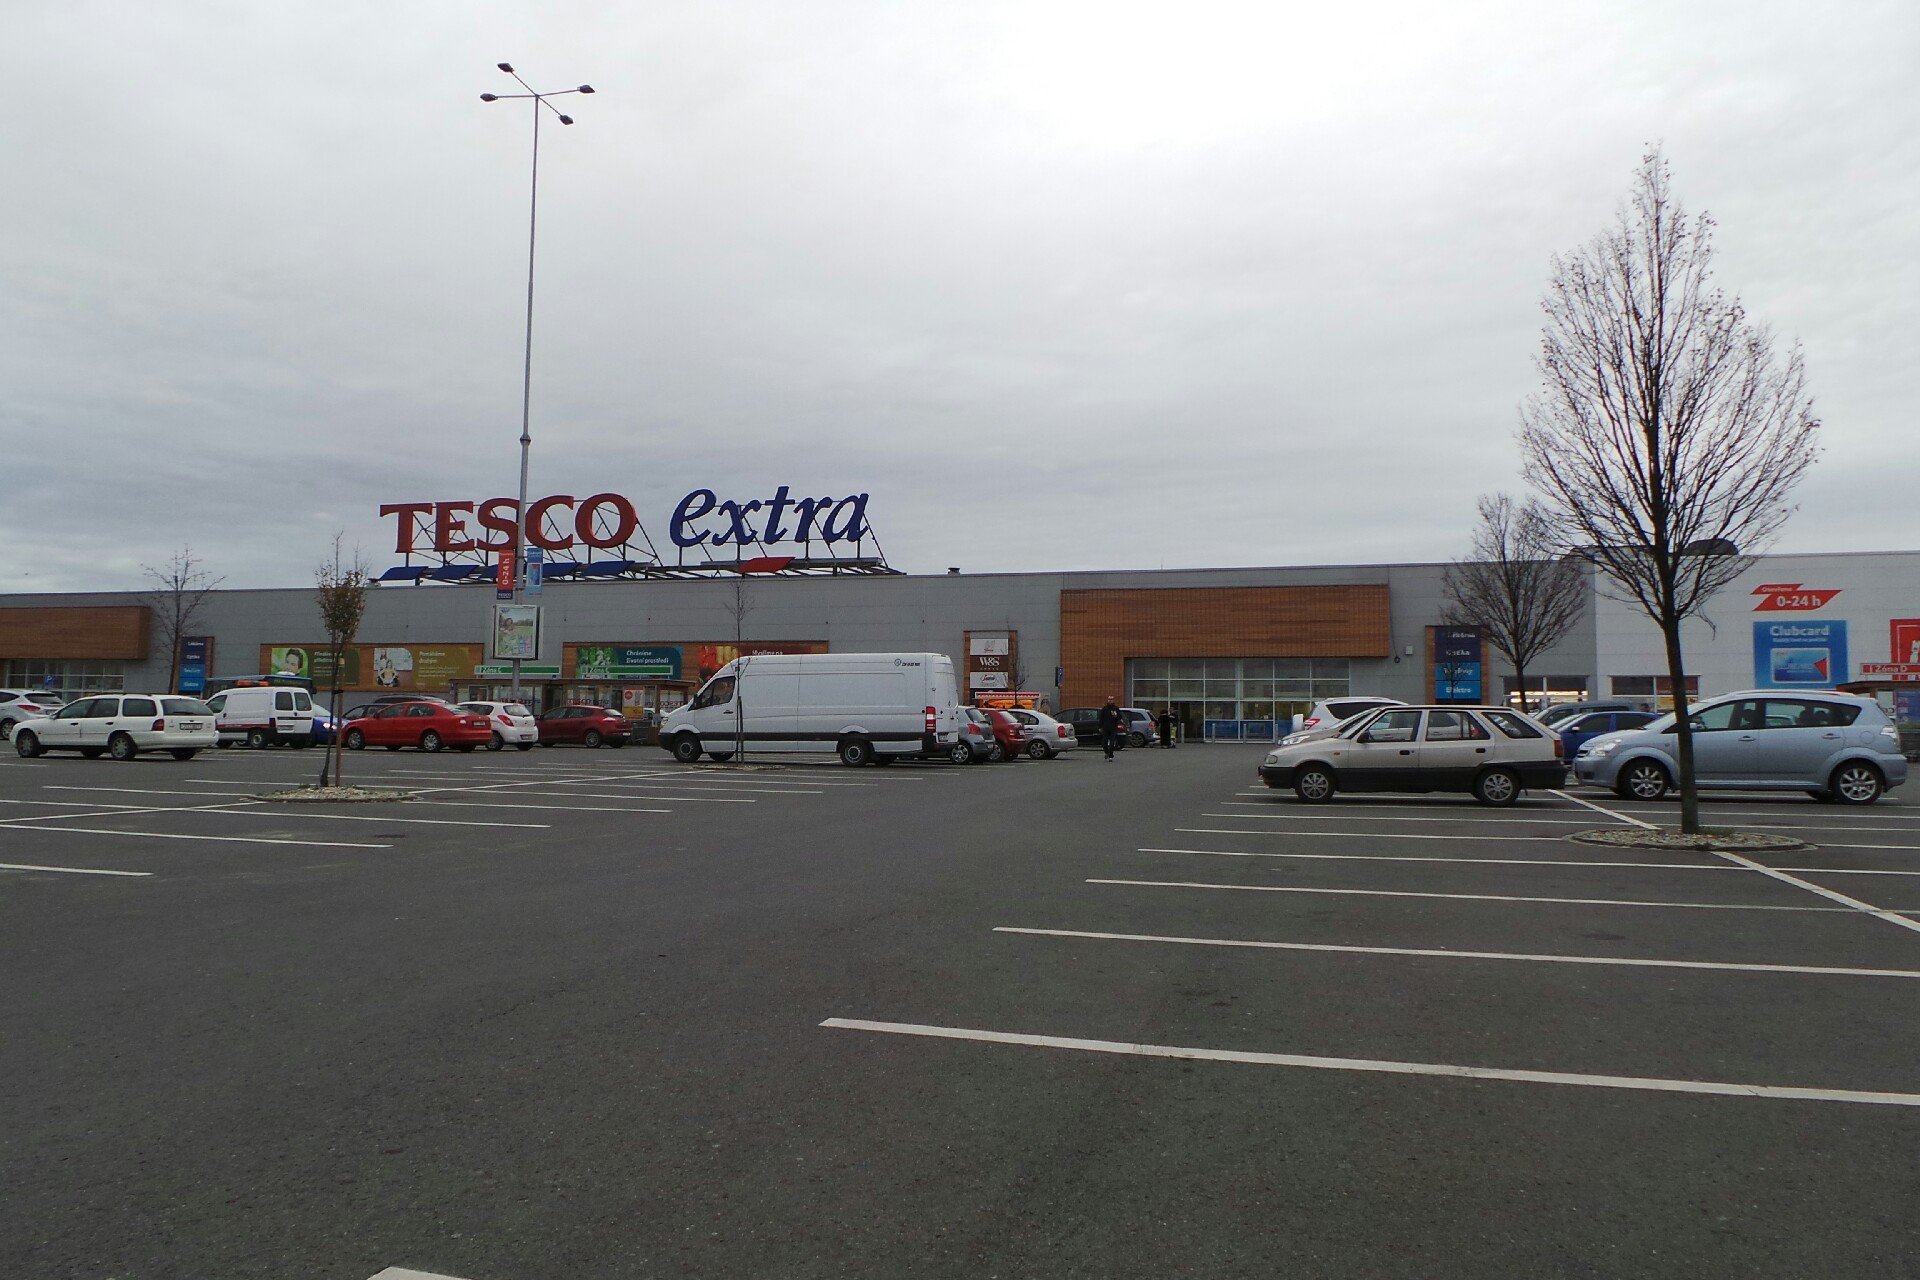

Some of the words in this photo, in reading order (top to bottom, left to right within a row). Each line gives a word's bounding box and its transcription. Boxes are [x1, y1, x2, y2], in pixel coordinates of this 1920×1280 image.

[380, 493, 638, 553] TESCO
[669, 486, 870, 547] extra
[1776, 596, 1808, 607] 0-24
[1812, 595, 1821, 606] h
[1770, 625, 1830, 636] Clubcard
[979, 656, 1000, 667] W&S
[1875, 665, 1898, 673] Zóna
